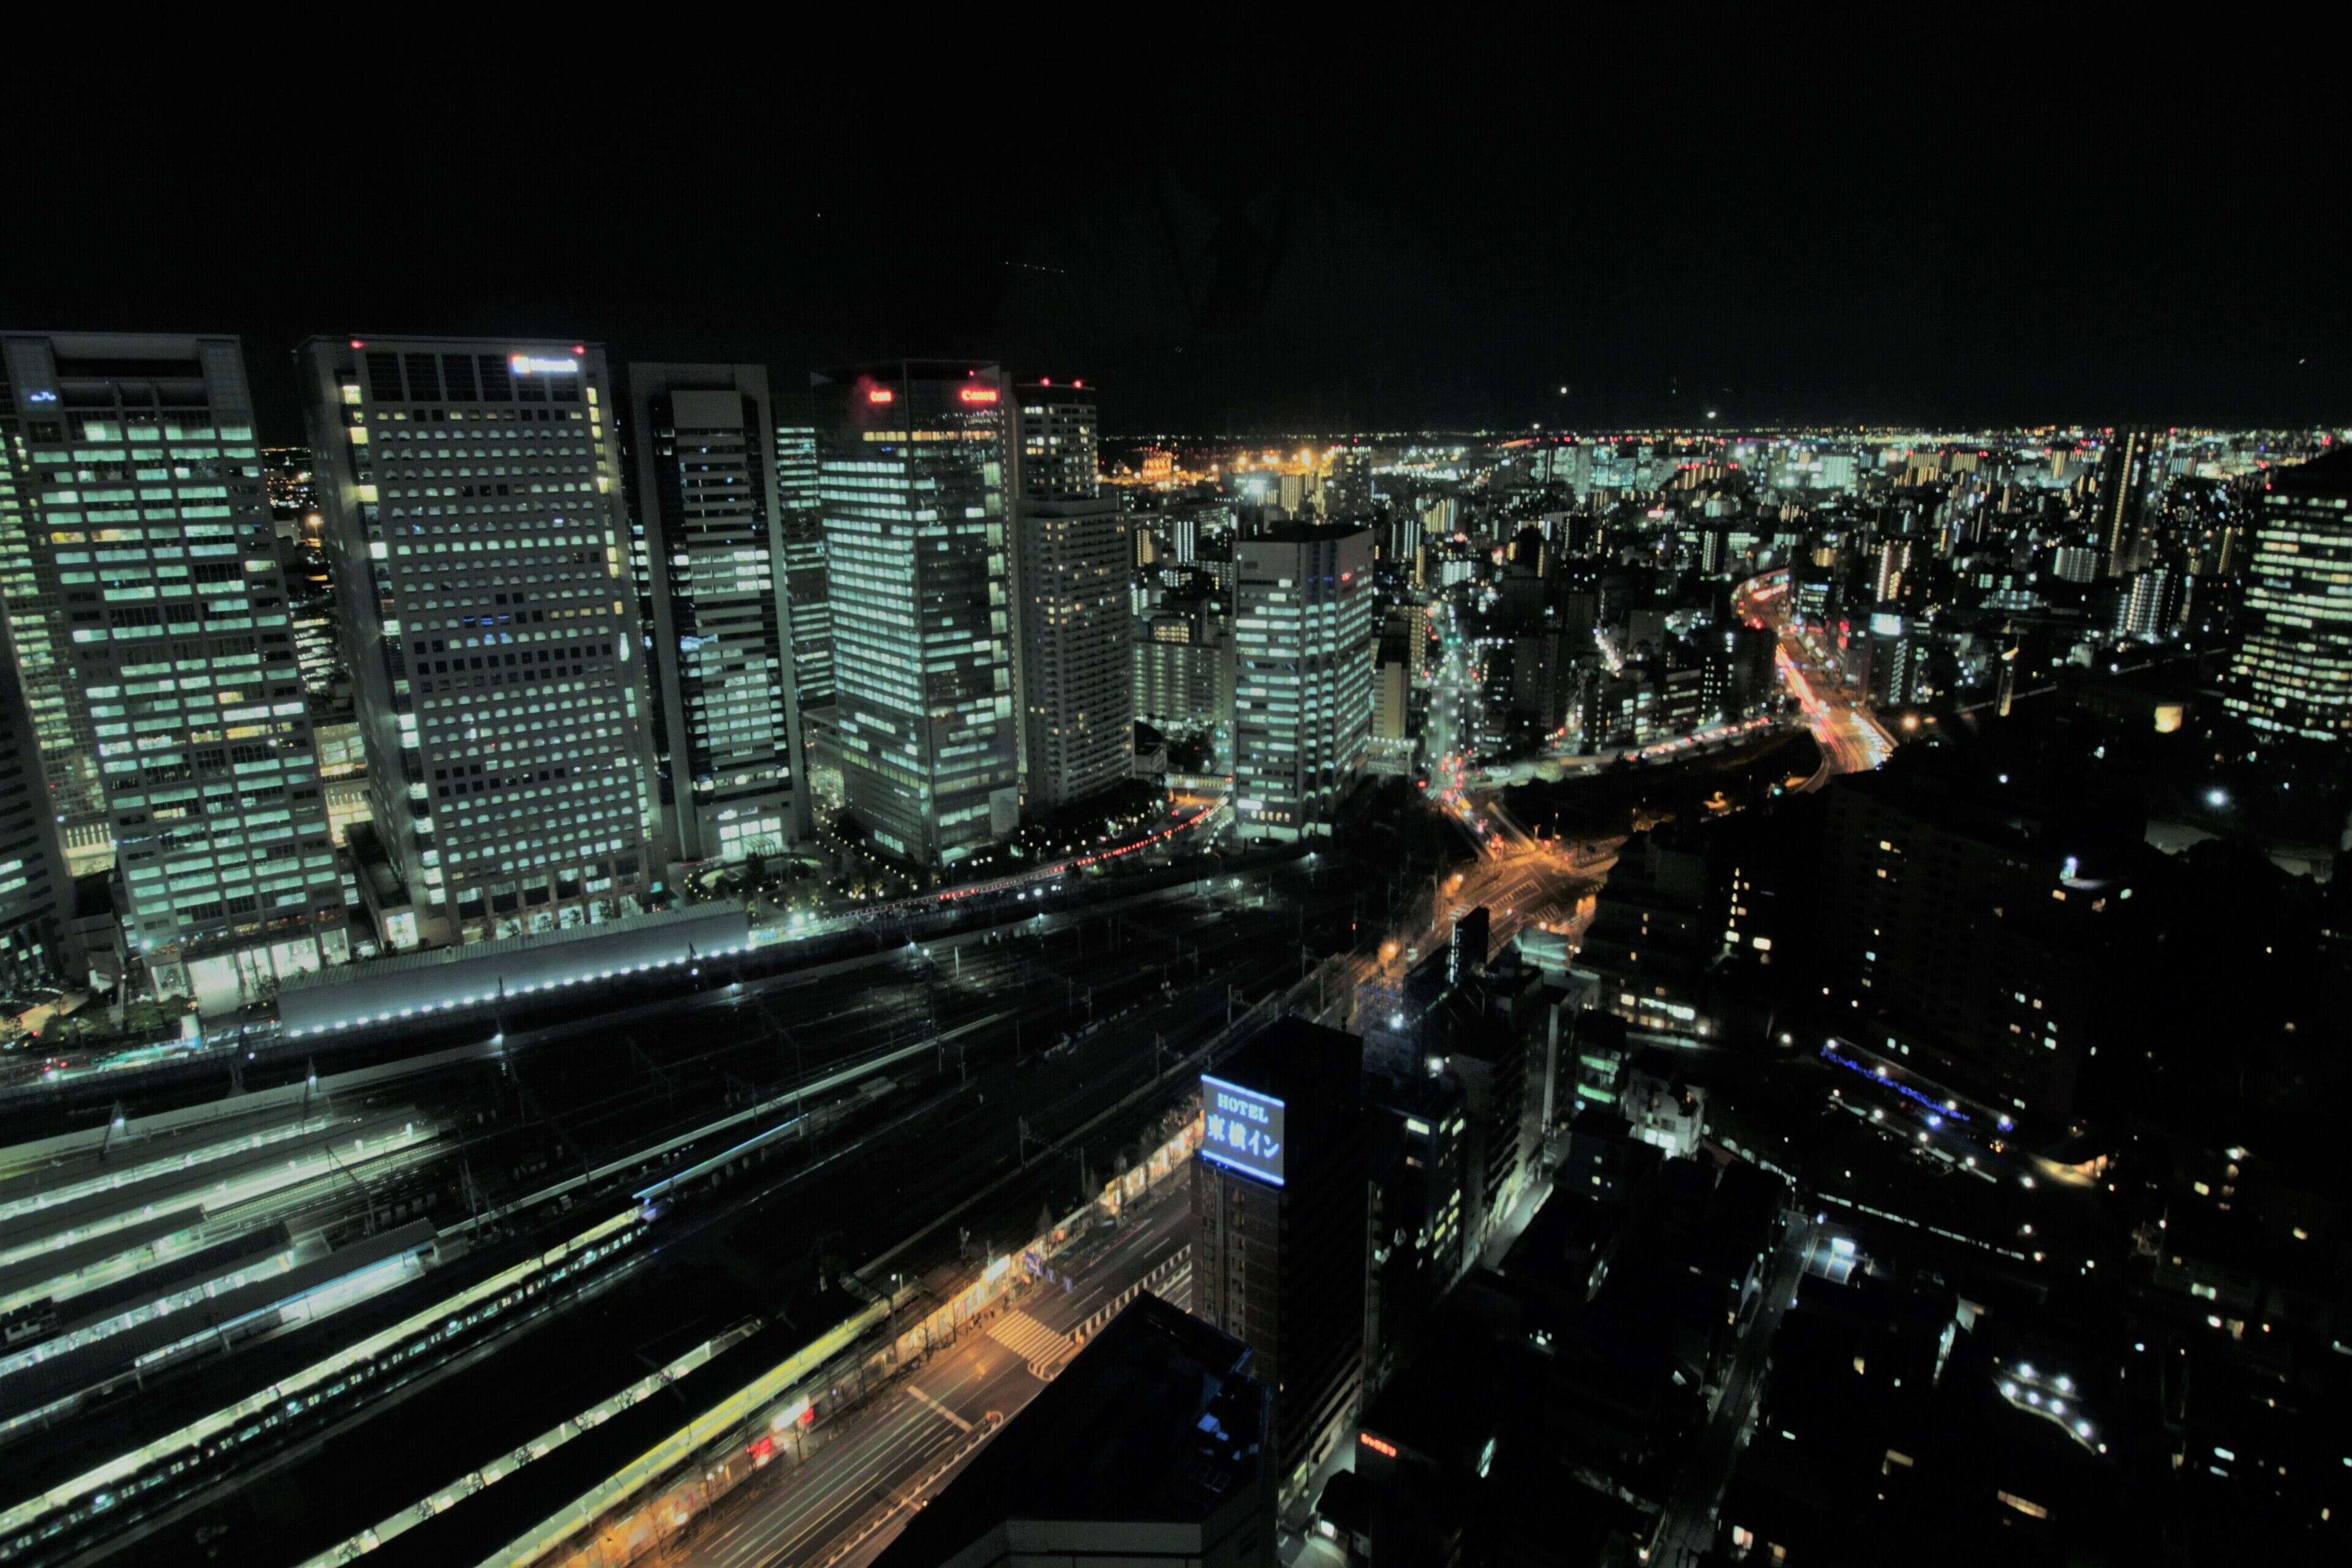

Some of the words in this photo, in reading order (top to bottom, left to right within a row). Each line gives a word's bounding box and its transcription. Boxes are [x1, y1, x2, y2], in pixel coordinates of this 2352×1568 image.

[1217, 1092, 1268, 1124] HOTEL
[1207, 1114, 1280, 1158] 東横イン
